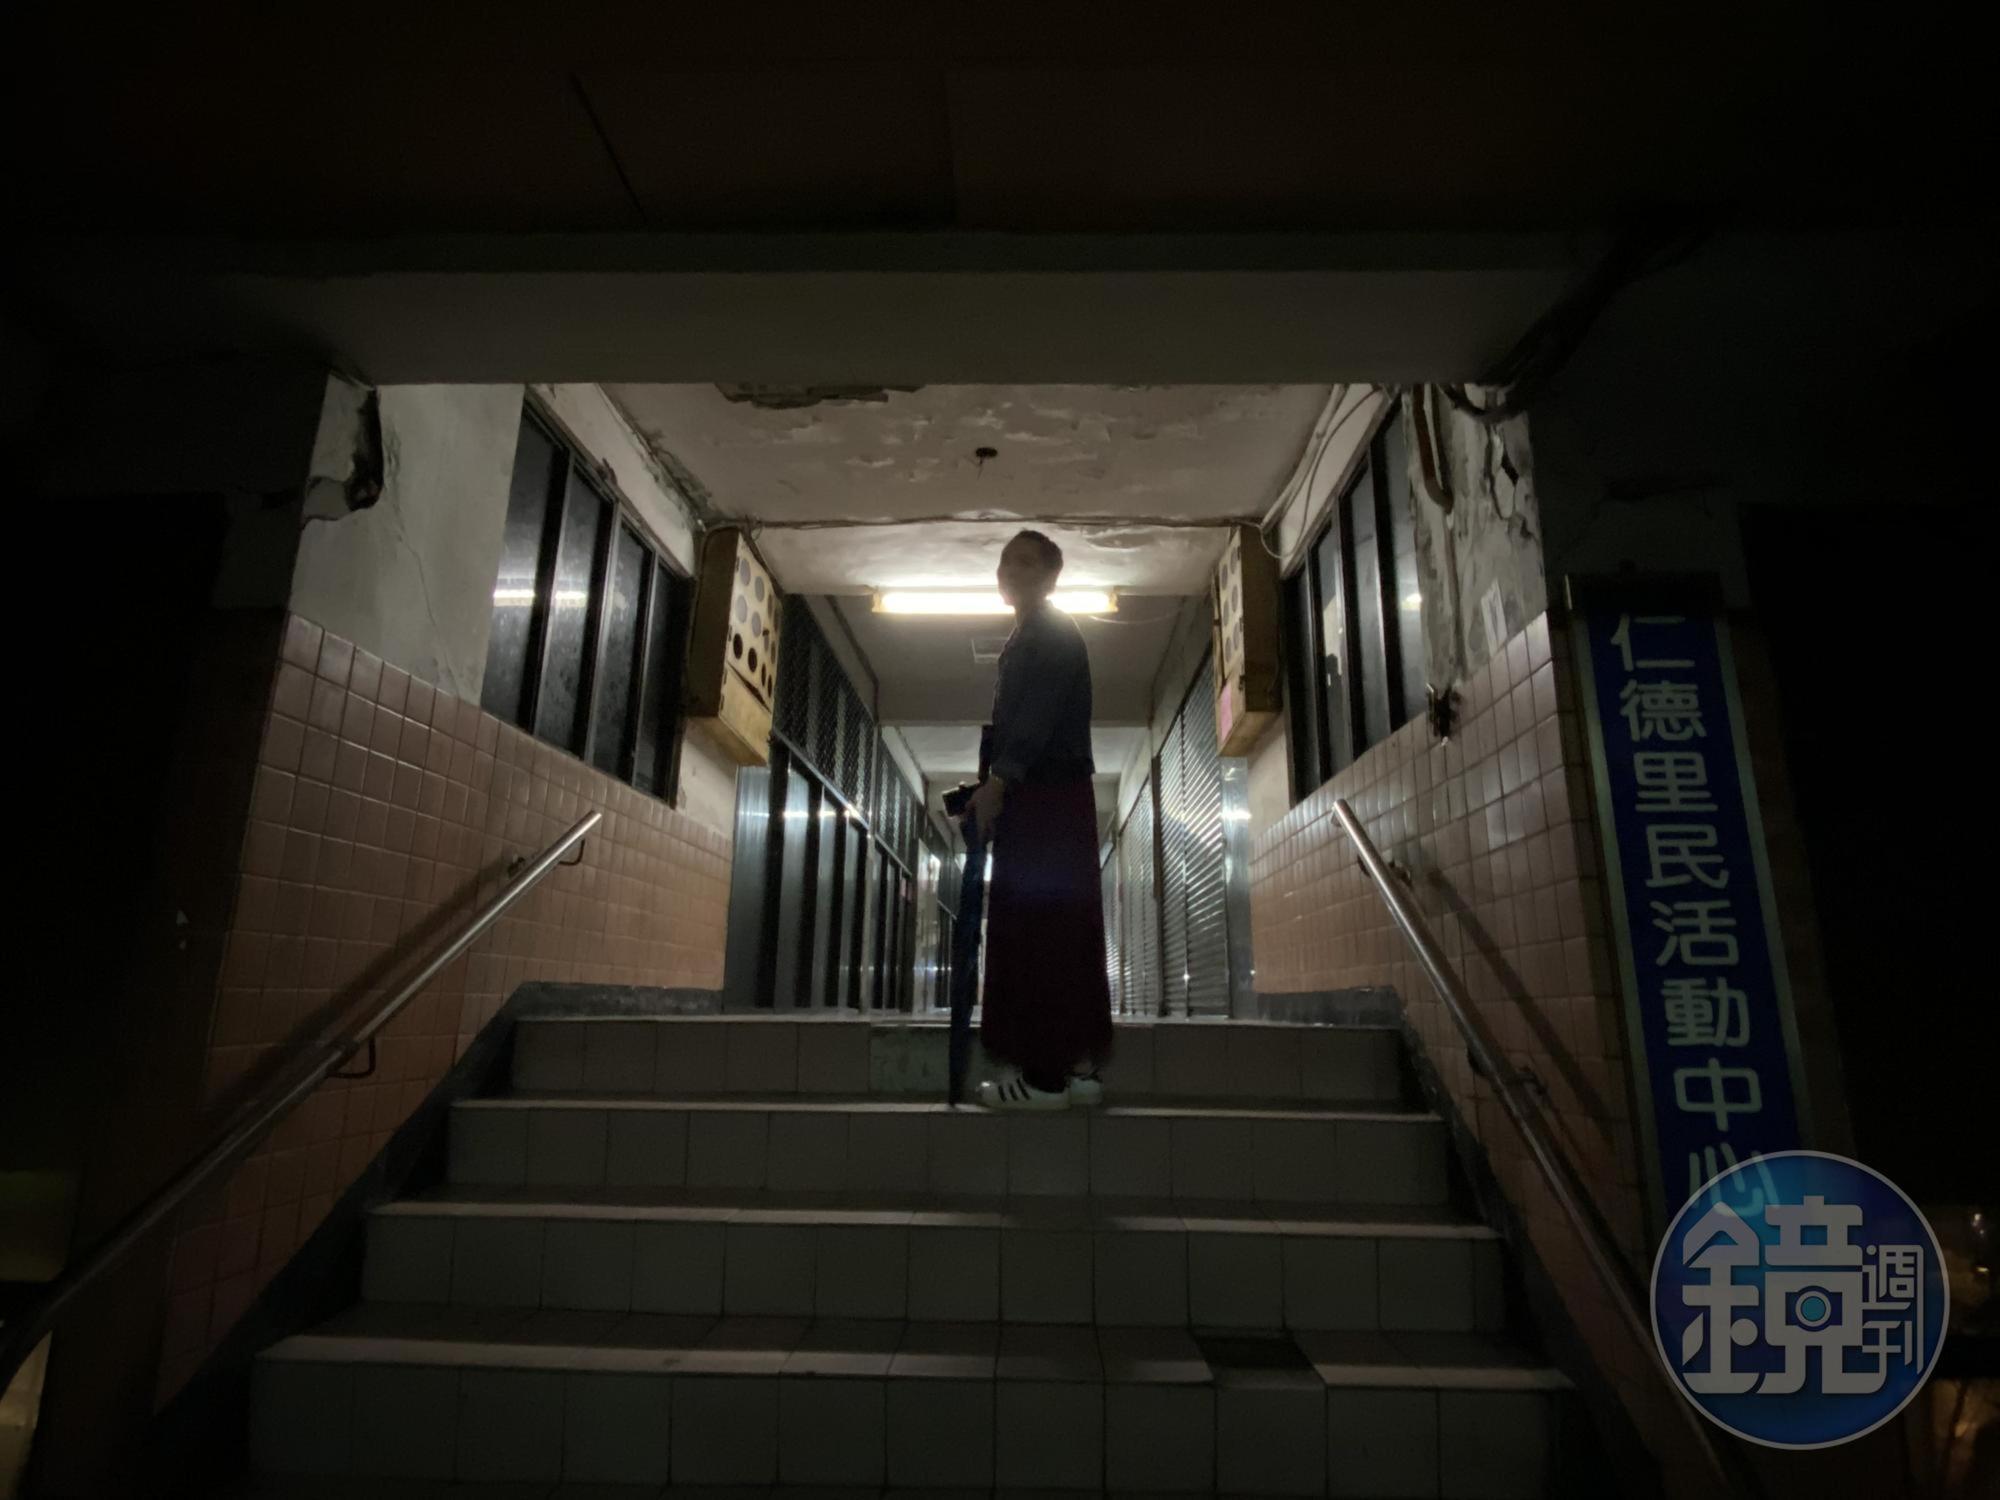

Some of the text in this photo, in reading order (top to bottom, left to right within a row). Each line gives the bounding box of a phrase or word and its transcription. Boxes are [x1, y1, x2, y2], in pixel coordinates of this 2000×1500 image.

[1610, 611, 1781, 1217] 仁德里民活動中心
